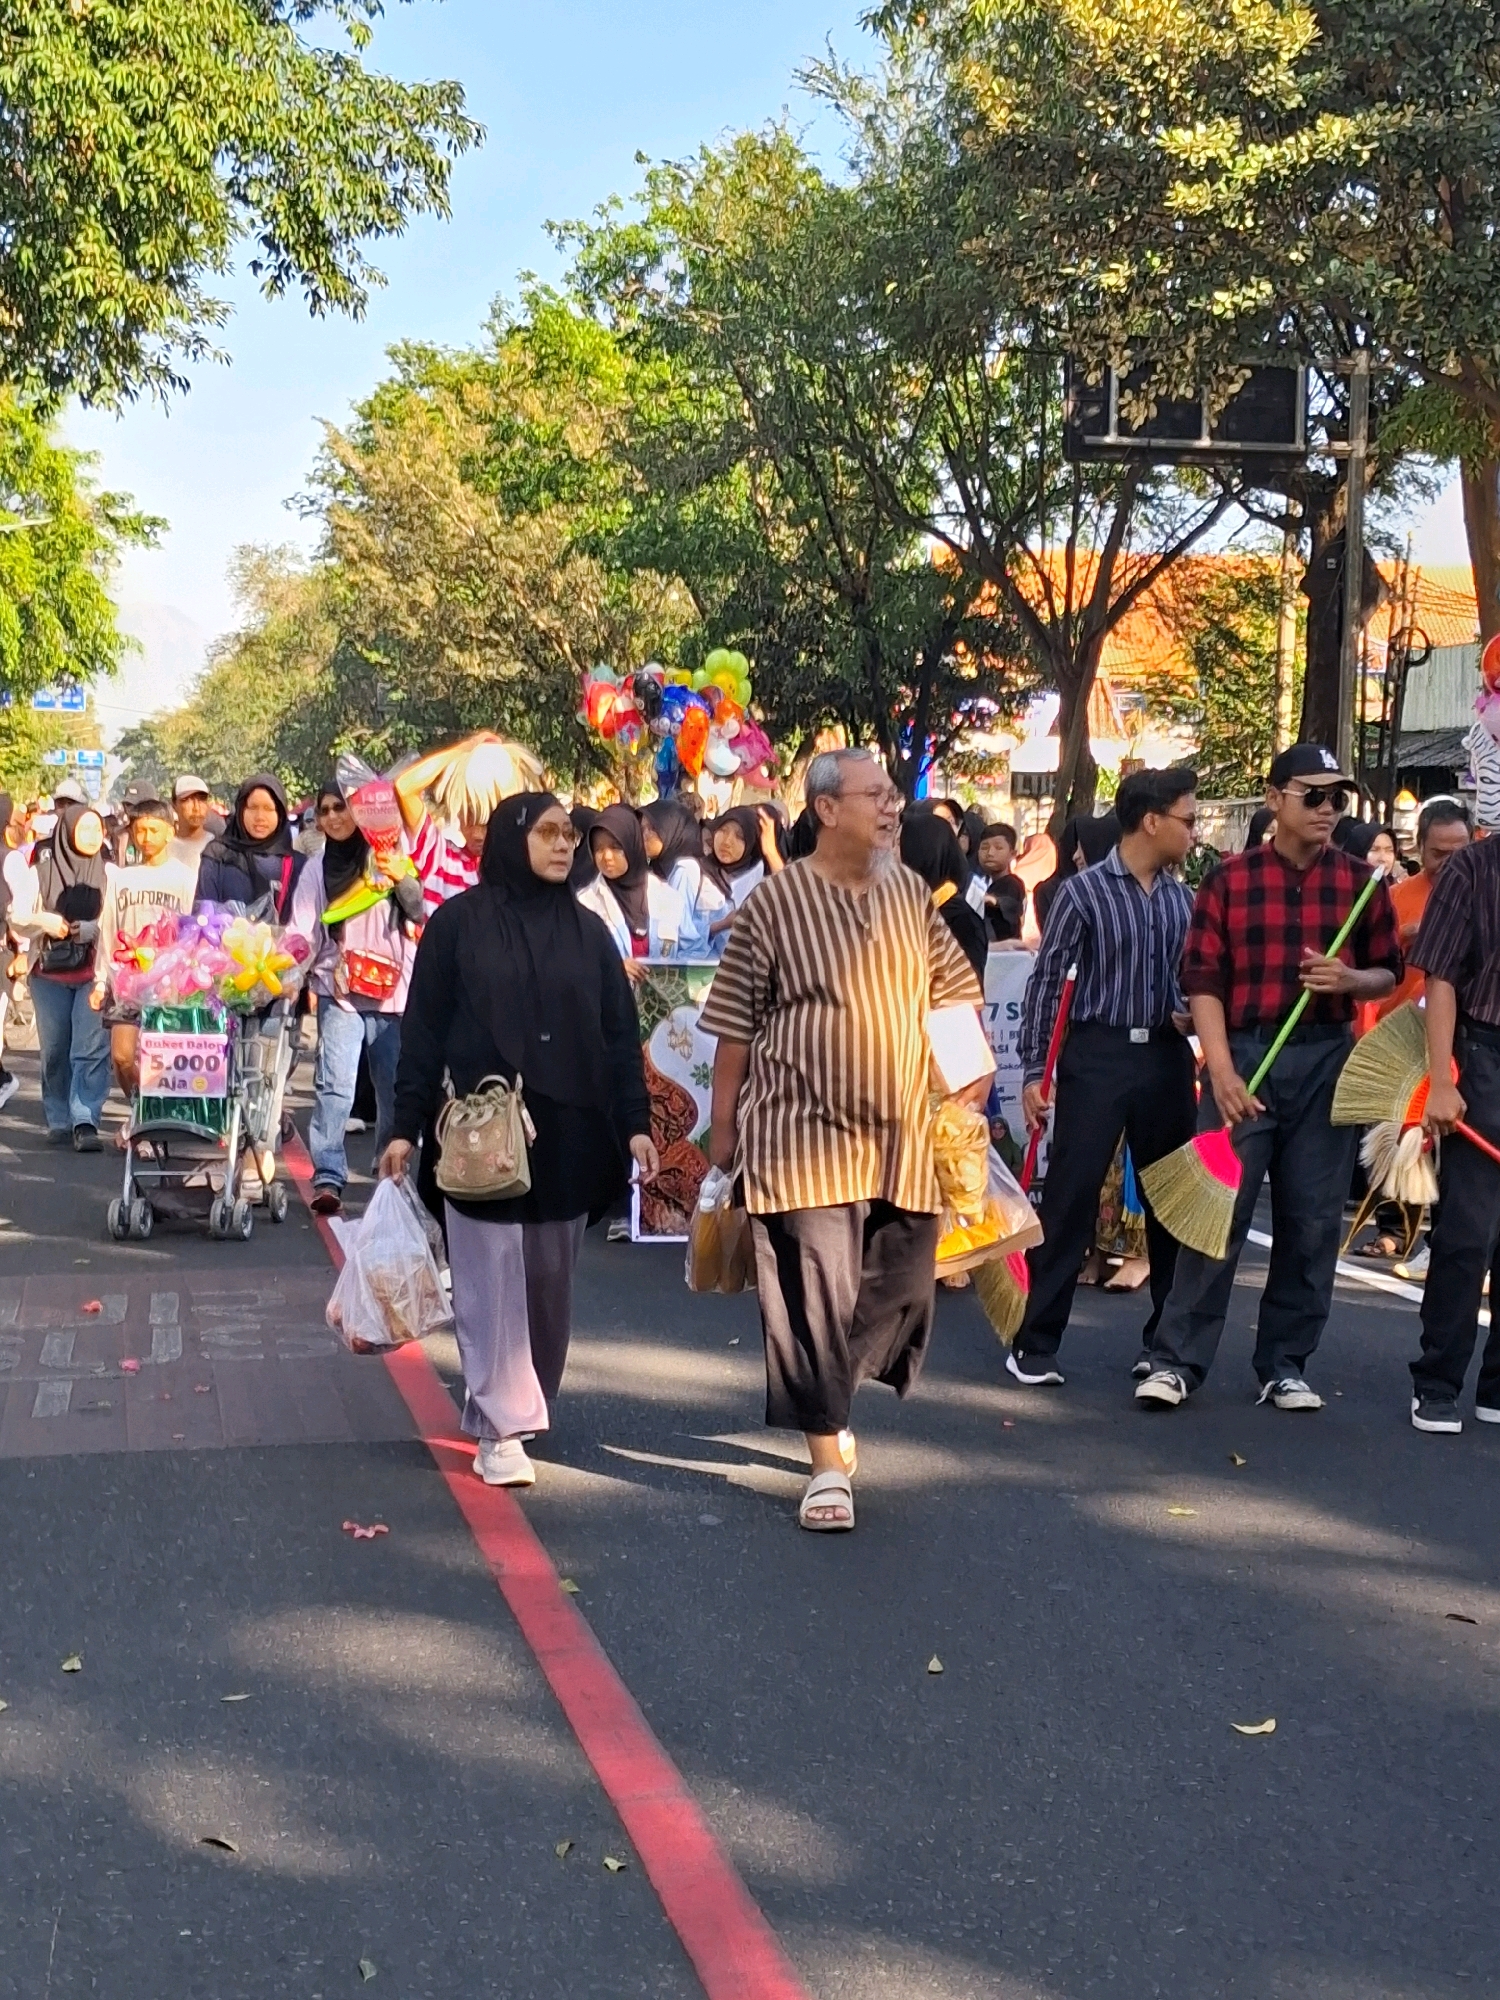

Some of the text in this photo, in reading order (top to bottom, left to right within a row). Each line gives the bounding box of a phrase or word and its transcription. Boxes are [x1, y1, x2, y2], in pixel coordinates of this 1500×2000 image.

[1319, 749, 1339, 770] LA
[117, 887, 181, 914] CALIFORNIA
[145, 1039, 184, 1050] Buket
[150, 1053, 221, 1073] 5.000
[158, 1076, 188, 1092] Aja
